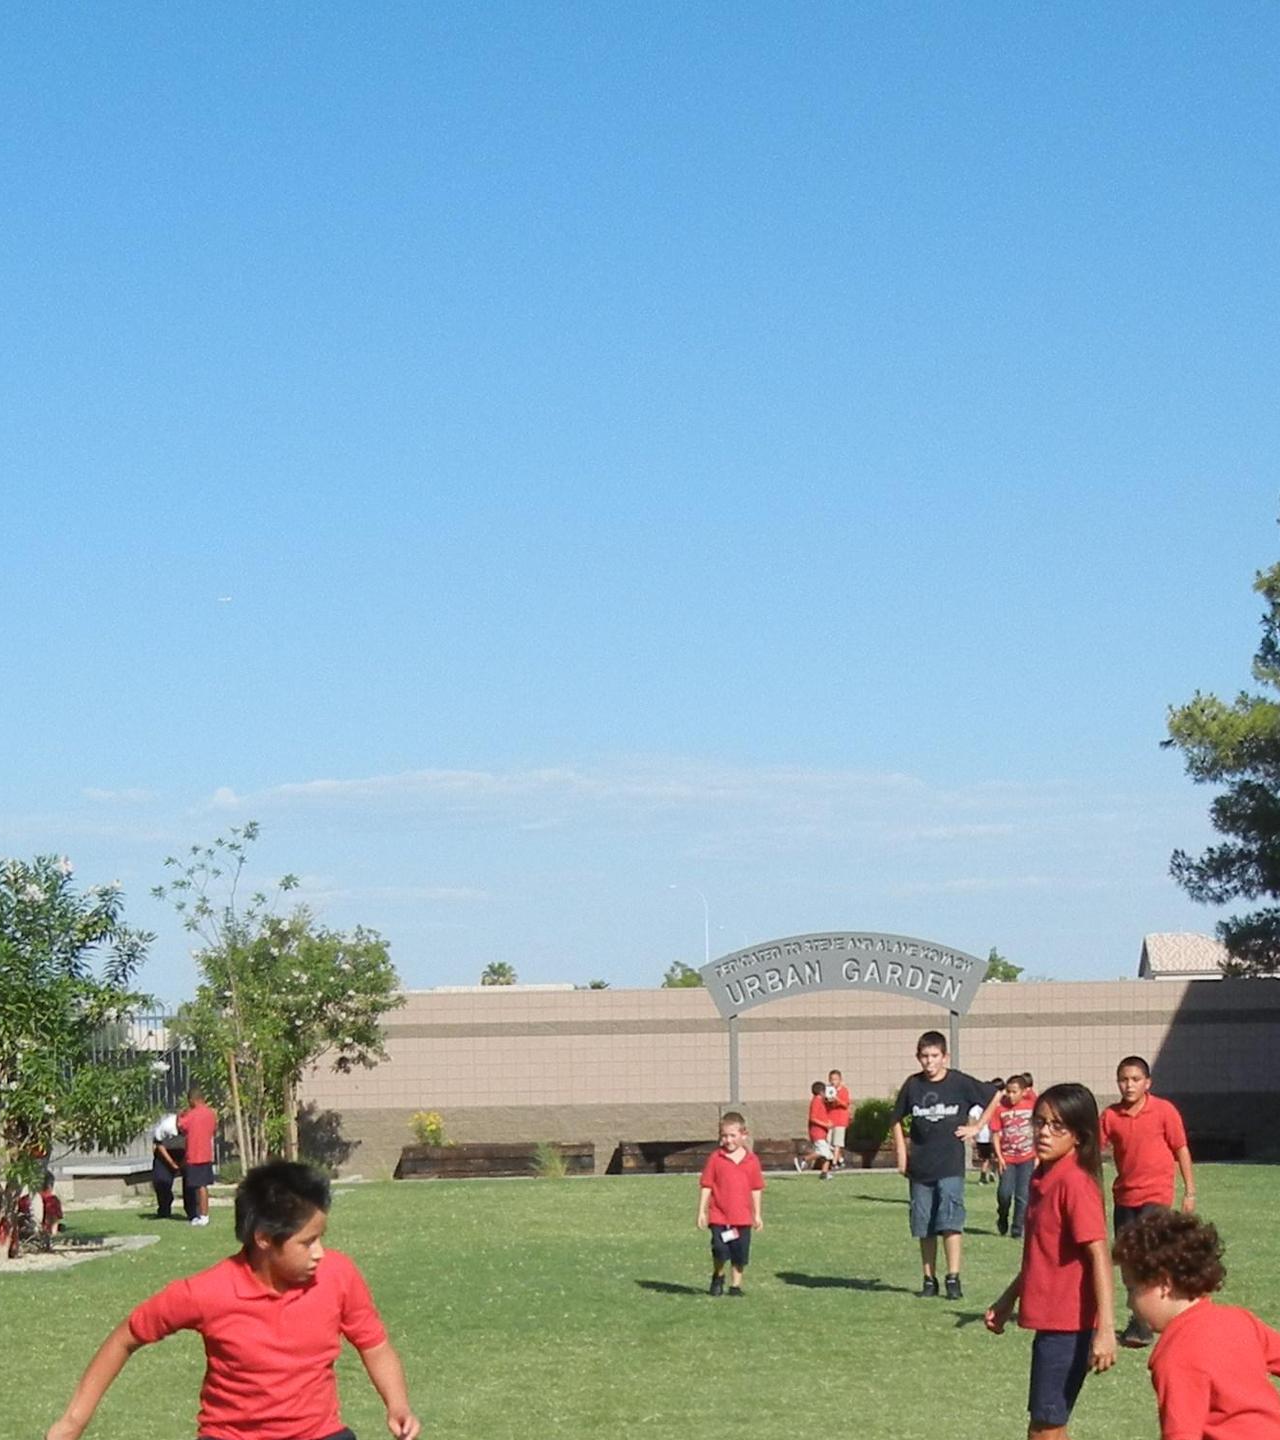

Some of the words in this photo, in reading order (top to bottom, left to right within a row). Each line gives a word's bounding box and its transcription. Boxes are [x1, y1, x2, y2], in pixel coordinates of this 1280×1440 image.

[784, 941, 802, 956] TO
[804, 937, 845, 953] STEVE
[847, 937, 874, 951] AND
[725, 959, 822, 1006] URBAN
[842, 957, 963, 1002] GARDEN
